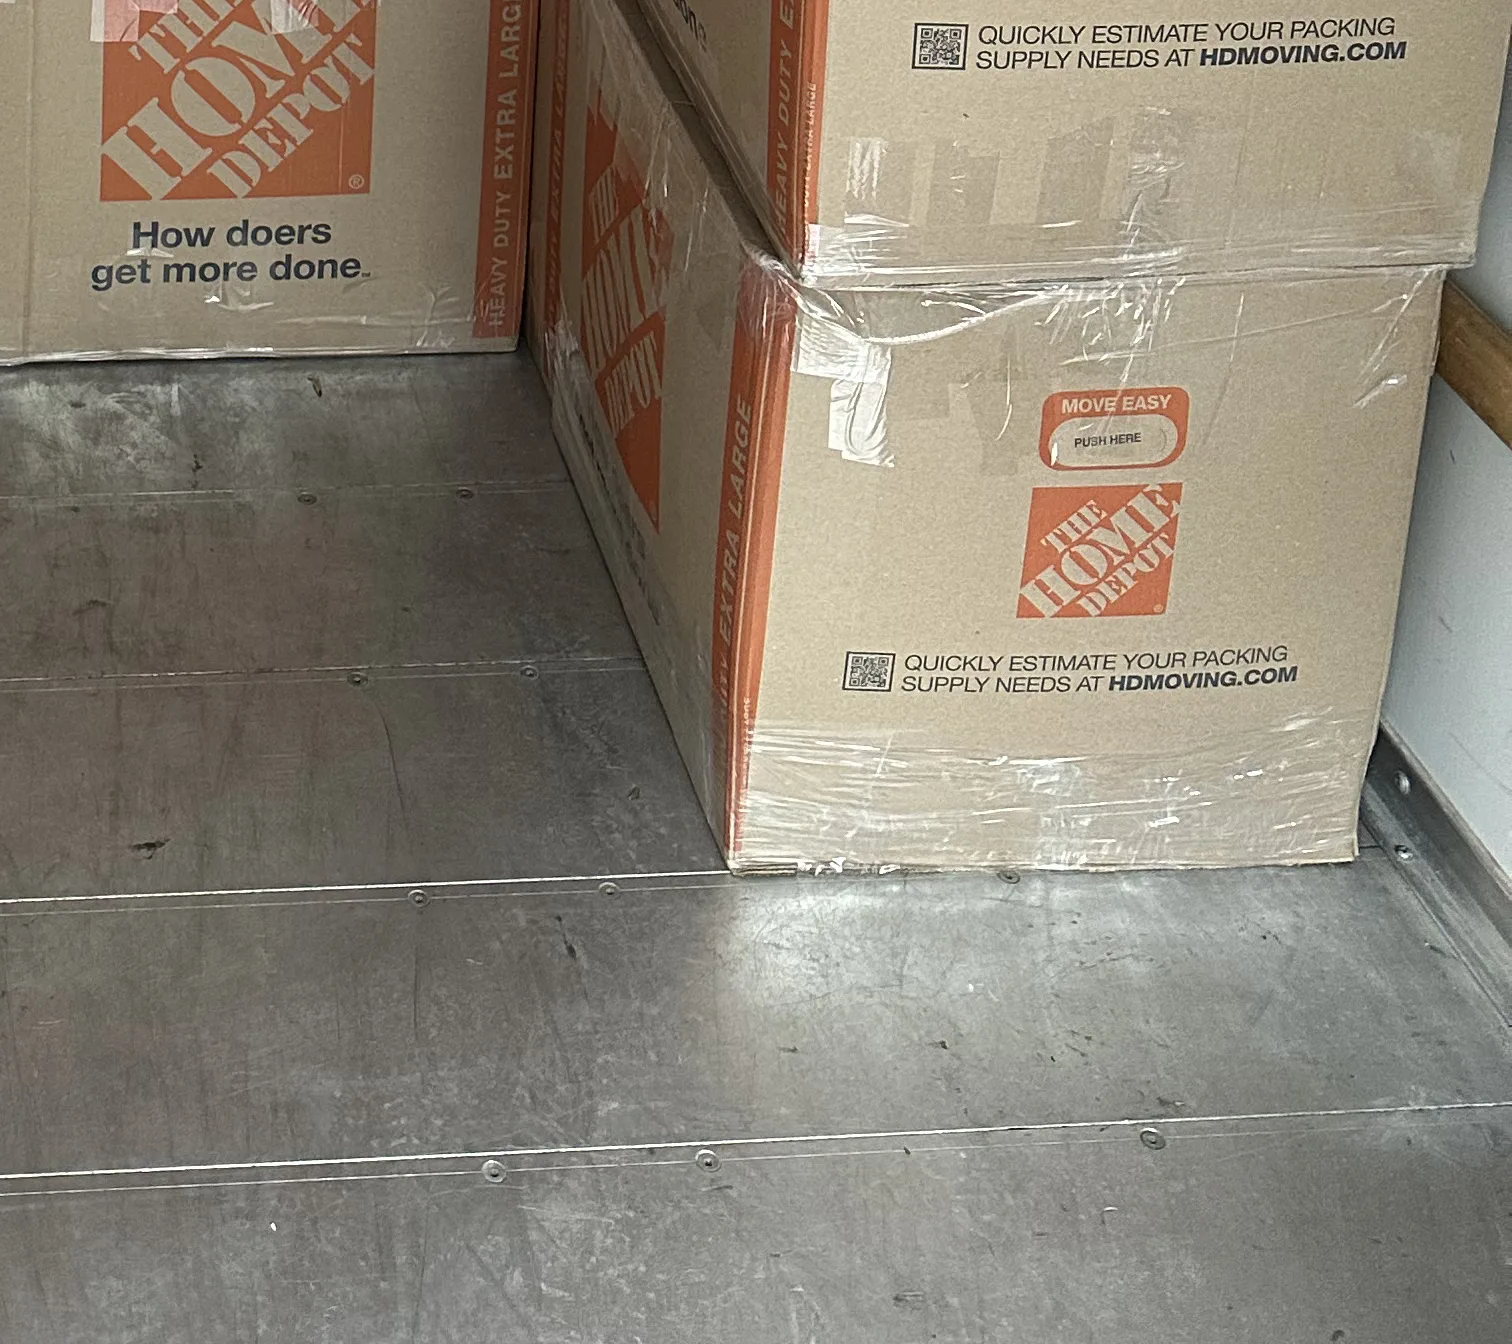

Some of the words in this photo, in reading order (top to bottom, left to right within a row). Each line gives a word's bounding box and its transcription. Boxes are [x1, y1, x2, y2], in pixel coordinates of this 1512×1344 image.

[979, 25, 1085, 46] QUICKLY
[1091, 24, 1208, 43] ESTIMATE
[1215, 21, 1284, 42] YOUR
[1290, 18, 1395, 38] PACKING
[976, 50, 1071, 70] SUPPLY
[1076, 49, 1159, 69] NEEDS
[1165, 48, 1195, 68] AT
[1200, 42, 1406, 66] HDMOVING.COM
[494, 89, 517, 180] EXTRA
[132, 220, 215, 250] How
[226, 219, 332, 248] doers
[494, 191, 511, 247] DUTY
[91, 260, 151, 292] get
[163, 257, 258, 282] more
[490, 259, 507, 326] HEAVY
[1062, 396, 1117, 414] MOVE
[1122, 393, 1171, 412] EASY
[1074, 435, 1104, 448] PUSH
[1108, 432, 1141, 446] HERE
[1040, 500, 1106, 554] THE
[1020, 484, 1179, 617] HOME
[1075, 535, 1174, 617] DEPOT
[904, 654, 1007, 674] QUICKLY
[1009, 652, 1118, 672] ESTIMATE
[1123, 651, 1188, 671] YOUR
[1193, 645, 1288, 667] PACKING
[902, 676, 991, 694] SUPPLY
[995, 674, 1070, 694] NEEDS
[1075, 674, 1102, 692] AT
[1108, 665, 1297, 692] HDMOVING.COM
